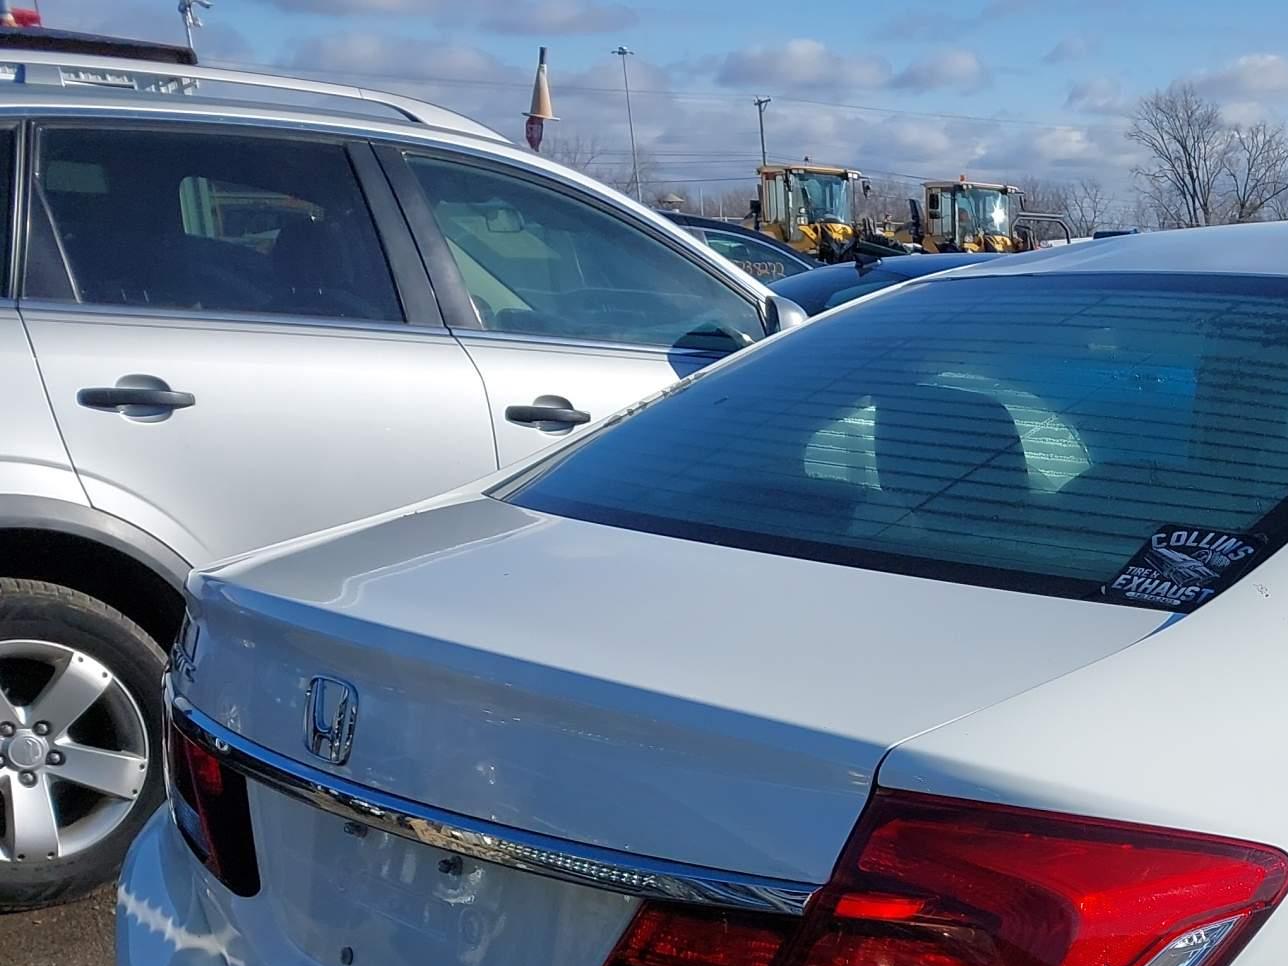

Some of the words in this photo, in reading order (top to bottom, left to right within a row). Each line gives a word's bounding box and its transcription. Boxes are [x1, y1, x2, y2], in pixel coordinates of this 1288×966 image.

[1152, 531, 1254, 561] COLLINS
[1126, 566, 1152, 577] TIRE
[1111, 575, 1215, 603] EXHAUST
